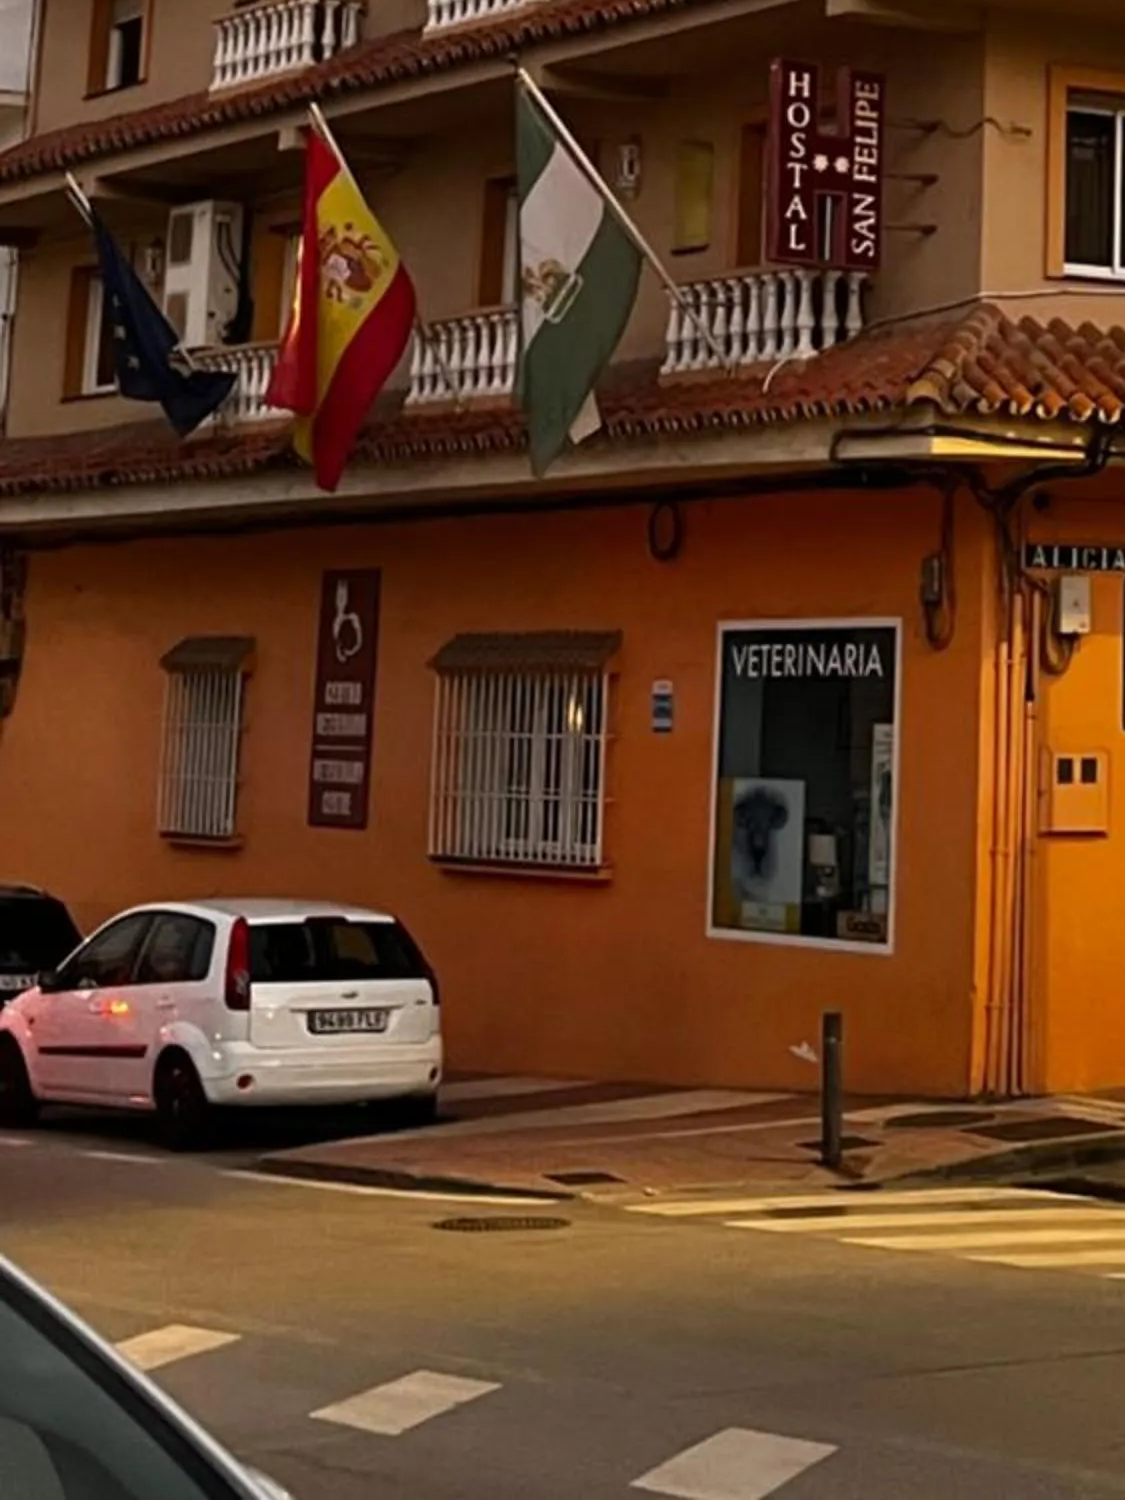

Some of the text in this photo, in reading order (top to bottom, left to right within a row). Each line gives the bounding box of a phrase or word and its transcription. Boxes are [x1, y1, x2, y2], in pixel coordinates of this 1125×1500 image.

[785, 70, 811, 251] HOSTAL
[851, 80, 881, 258] SAN FELIPE
[730, 642, 884, 678] VETERINARIA
